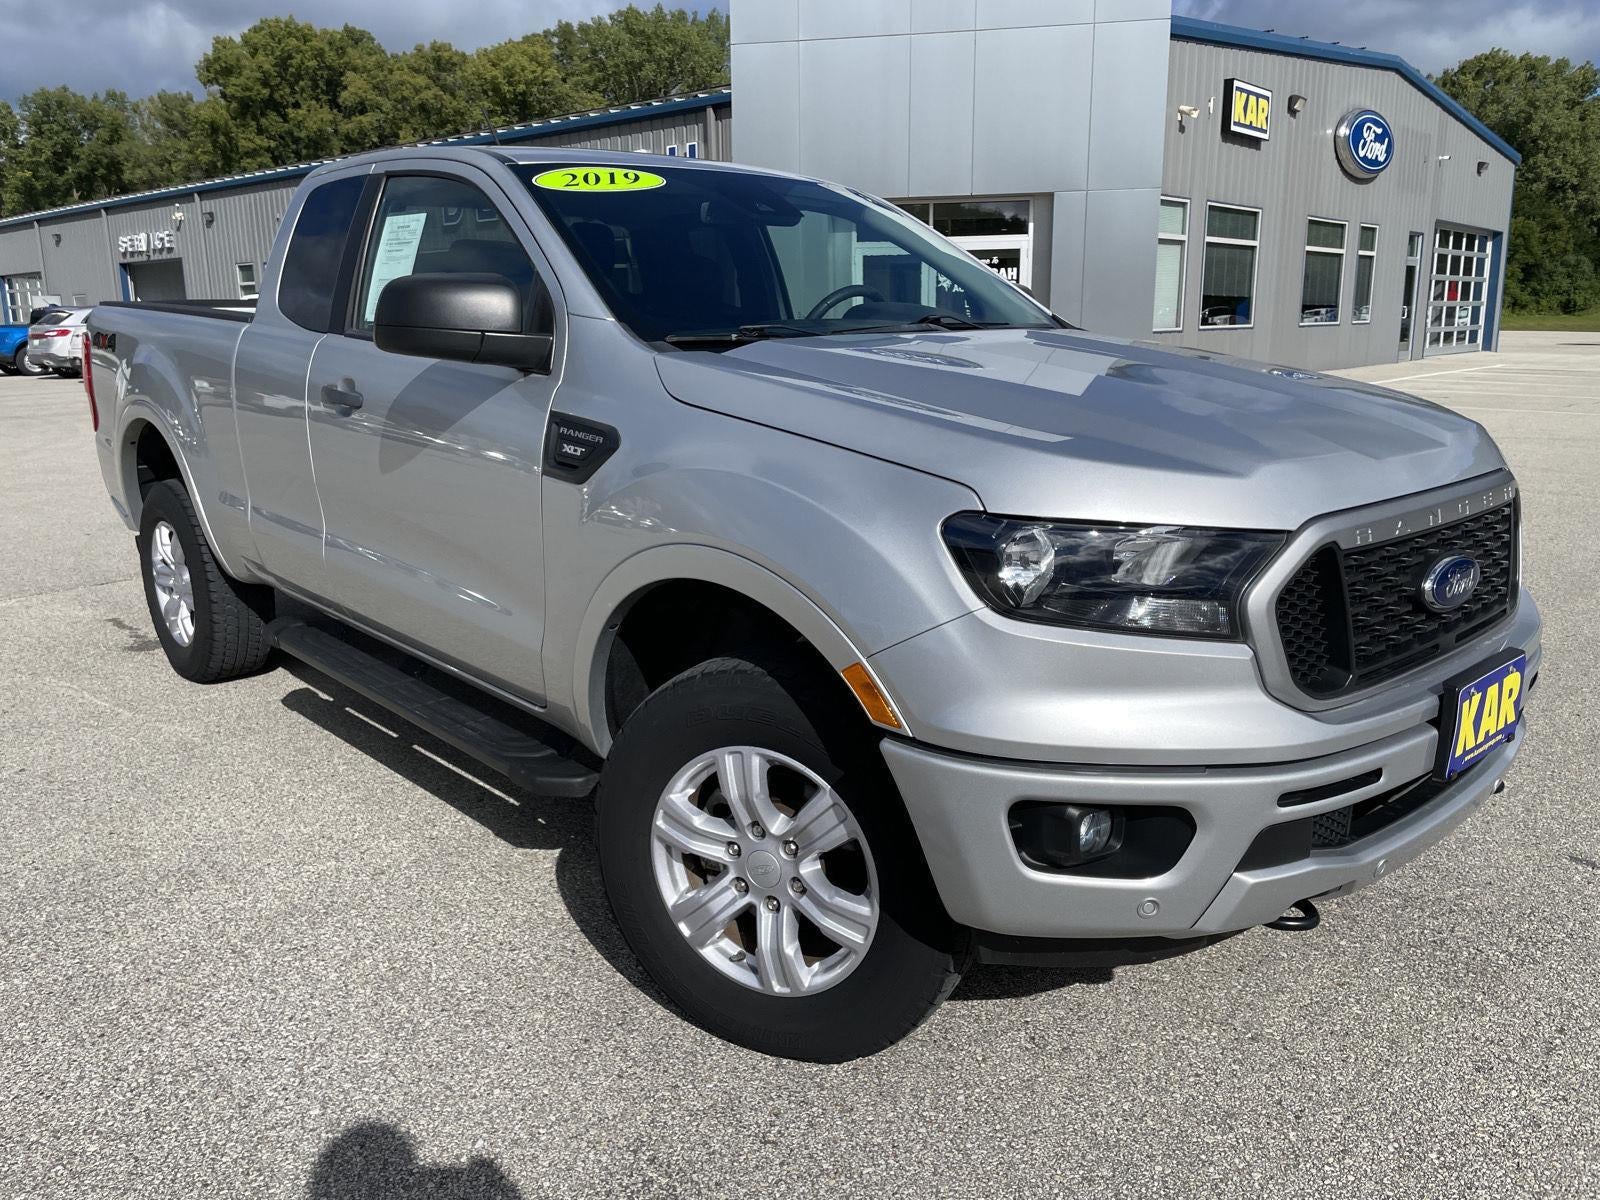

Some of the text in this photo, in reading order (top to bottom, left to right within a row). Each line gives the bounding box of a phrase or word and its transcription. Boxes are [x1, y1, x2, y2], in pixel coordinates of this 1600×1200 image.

[1233, 90, 1270, 130] KAR
[1358, 122, 1388, 163] Ford
[561, 171, 641, 188] 2019
[118, 230, 175, 252] SERVICE
[560, 426, 604, 444] RANGER
[562, 443, 585, 456] XLT
[1446, 564, 1475, 598] Ford
[1455, 671, 1522, 758] KAR
